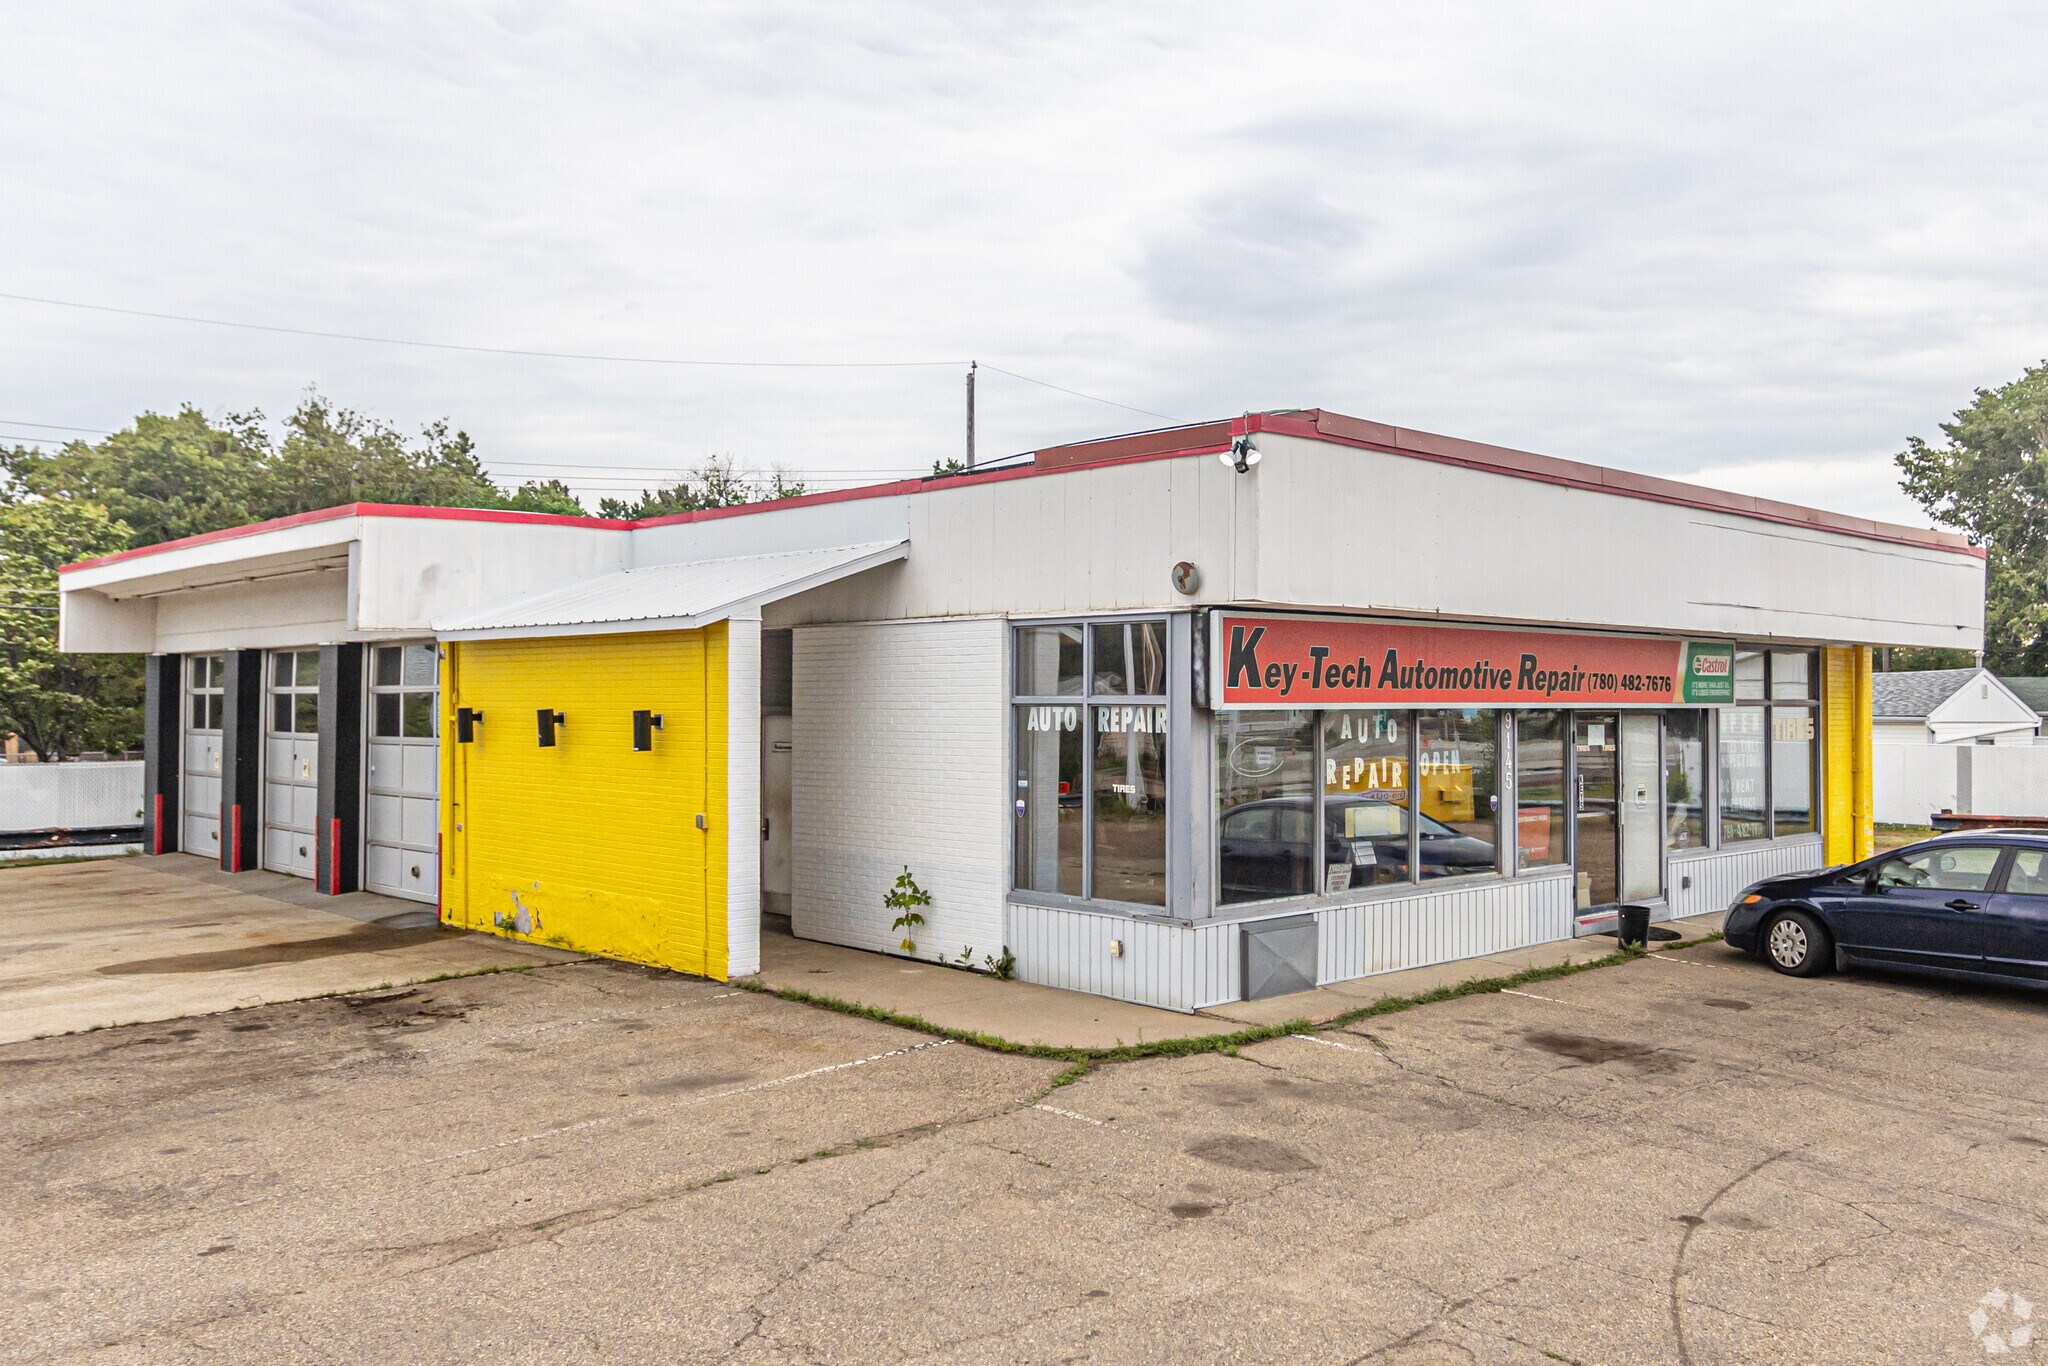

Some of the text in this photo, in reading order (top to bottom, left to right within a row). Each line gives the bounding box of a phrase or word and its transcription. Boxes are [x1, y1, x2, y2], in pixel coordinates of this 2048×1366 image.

[1226, 625, 1672, 697] Key-Tech Automotive Repair (780) 482-7676
[1702, 657, 1728, 673] Castrol
[1027, 706, 1167, 733] AUTO REPAIR
[1340, 713, 1398, 744] AUTO
[1420, 749, 1461, 777] OPEN
[1503, 711, 1513, 790] 9145
[1326, 756, 1402, 790] REPAIR
[1112, 783, 1136, 794] TIRES
